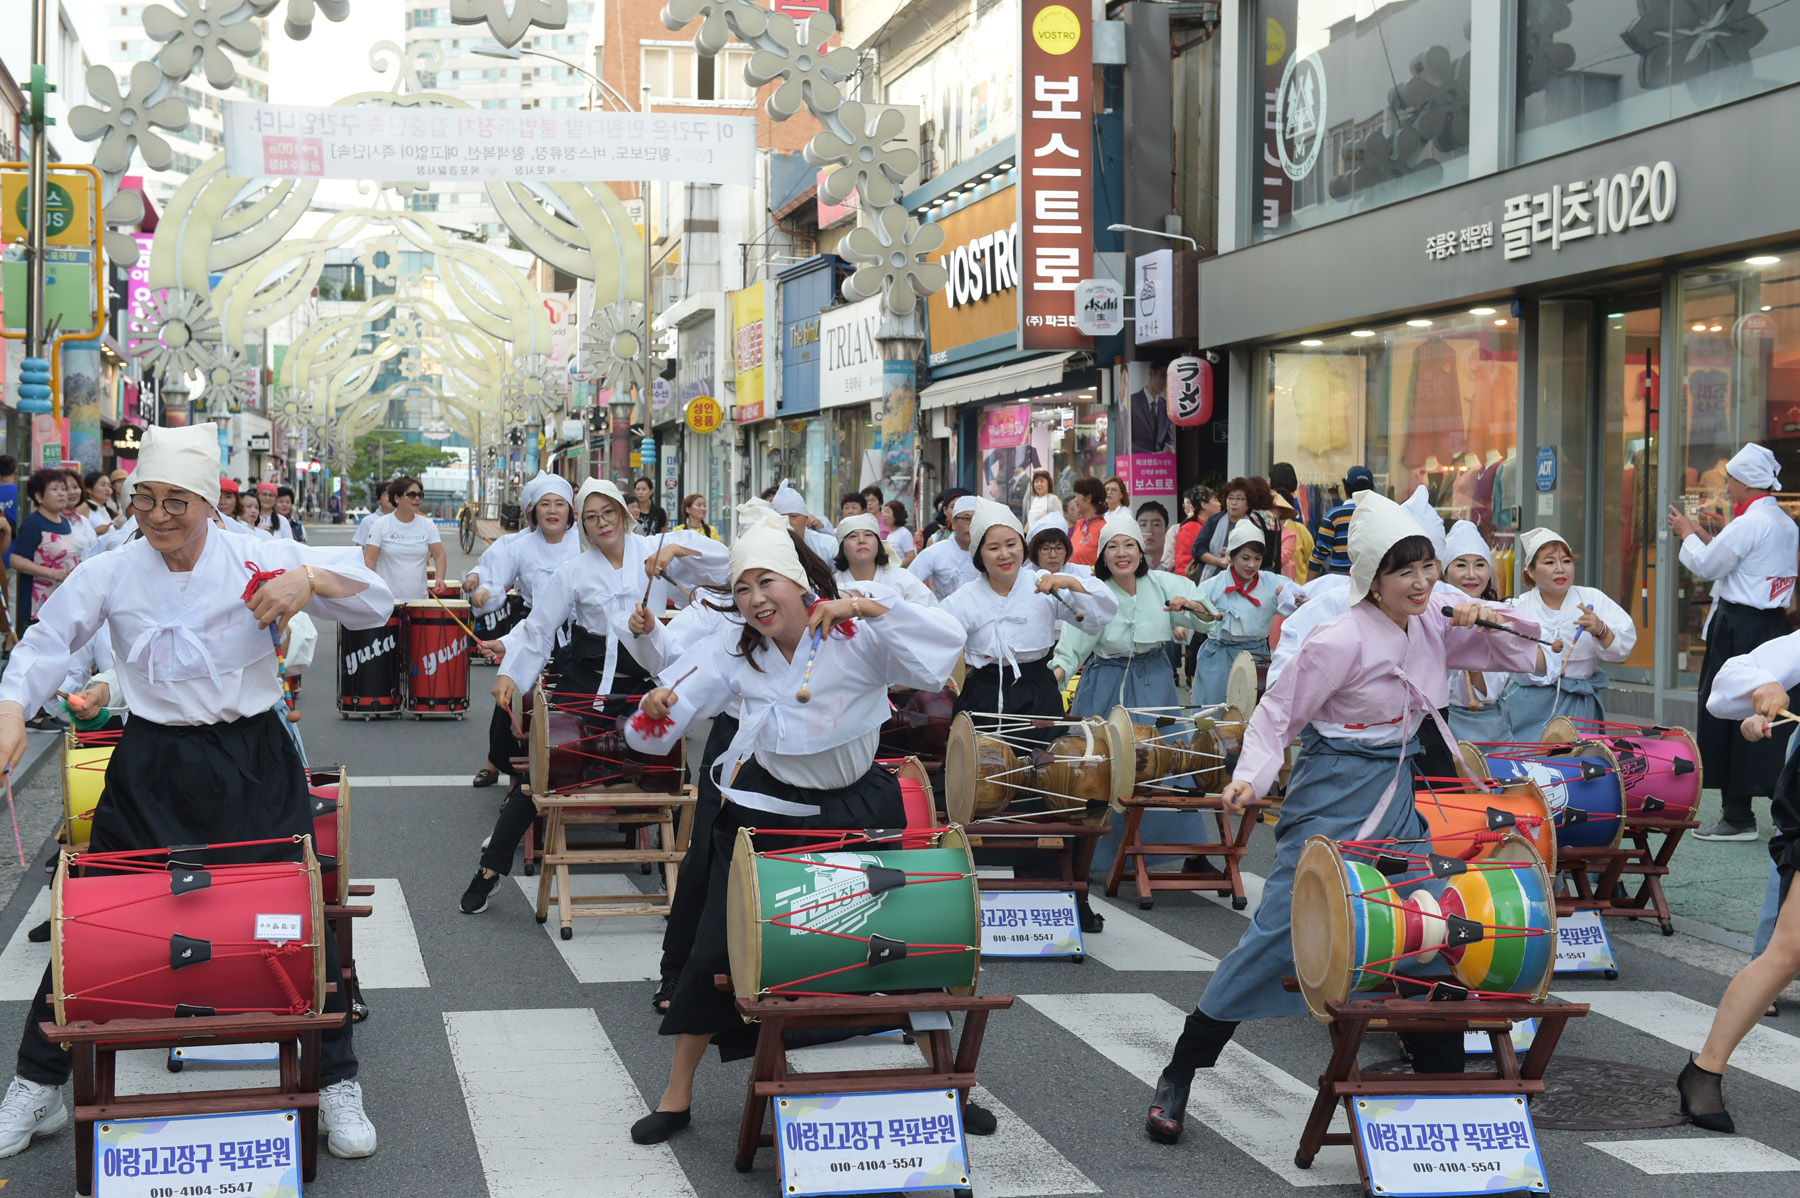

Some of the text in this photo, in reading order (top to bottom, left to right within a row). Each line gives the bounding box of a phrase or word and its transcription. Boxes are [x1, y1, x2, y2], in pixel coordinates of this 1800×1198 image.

[1038, 31, 1076, 40] VOSTRO
[1032, 75, 1082, 291] 보스트로
[1425, 230, 1458, 261] 주름옷
[1459, 221, 1494, 254] 전문점
[46, 250, 77, 262] 포극장
[1084, 297, 1118, 311] Asahi
[1025, 314, 1043, 328] (주)
[552, 328, 566, 336] orld
[790, 324, 803, 349] The
[1176, 361, 1201, 419] ラーメン
[693, 402, 714, 415] 성인
[693, 415, 714, 428] 용품
[1538, 460, 1553, 477] ADT
[1135, 479, 1174, 491] 보스트로
[345, 633, 396, 675] yuta
[422, 633, 468, 676] yuta
[1030, 907, 1075, 928] 목포분원
[993, 933, 1055, 944] 010-4104-5547
[1560, 926, 1604, 946] 목포분원
[786, 1114, 957, 1153] 아랑고고장구 목포분원
[1367, 1121, 1529, 1153] 아랑고고장구 목포분원
[103, 1137, 292, 1178] 아랑고고장구 목포분원
[830, 1156, 924, 1173] 010-4104-5547
[1413, 1160, 1502, 1174] 010-4104-5547
[149, 1181, 253, 1198] 010-4104-5547
